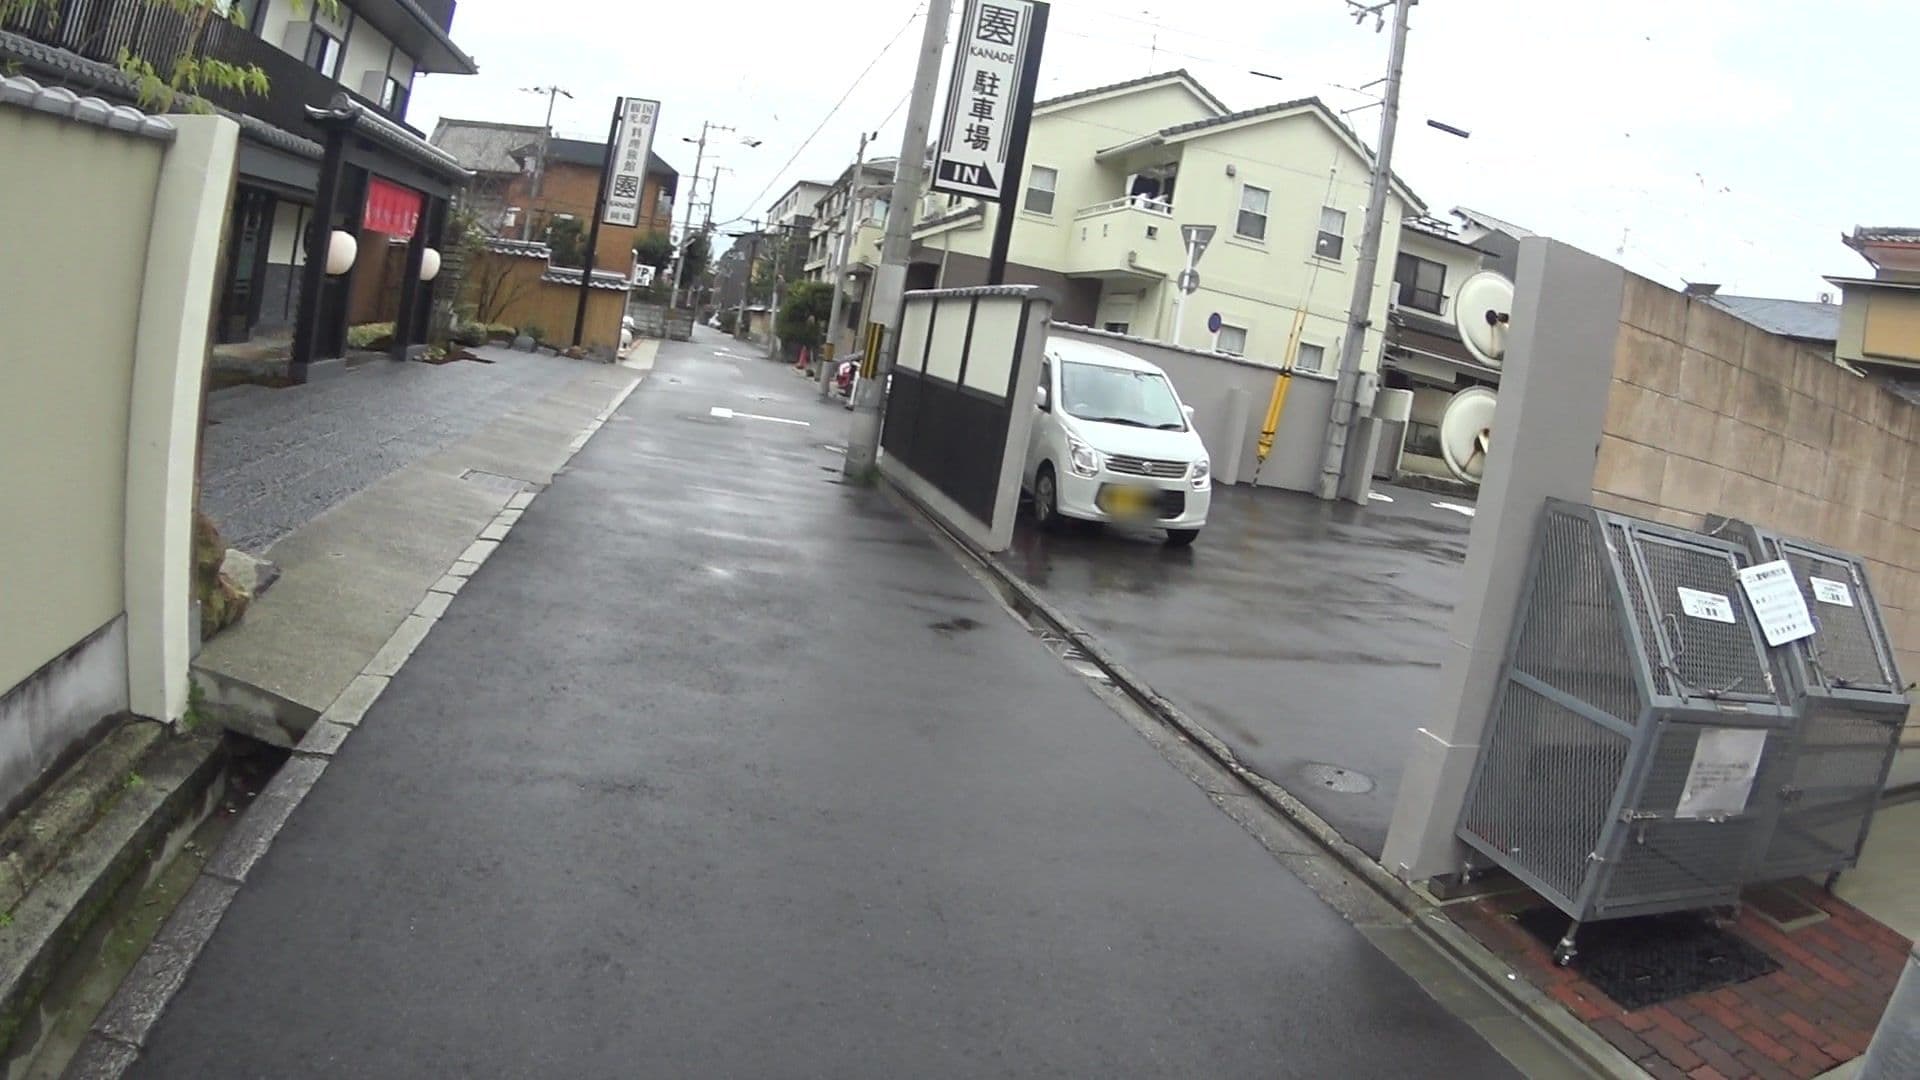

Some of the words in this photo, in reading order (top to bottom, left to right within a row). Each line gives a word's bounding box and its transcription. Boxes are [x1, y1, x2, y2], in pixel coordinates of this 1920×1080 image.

[969, 46, 1015, 64] KANADE
[963, 70, 1001, 151] 駐車場
[953, 164, 980, 184] IN
